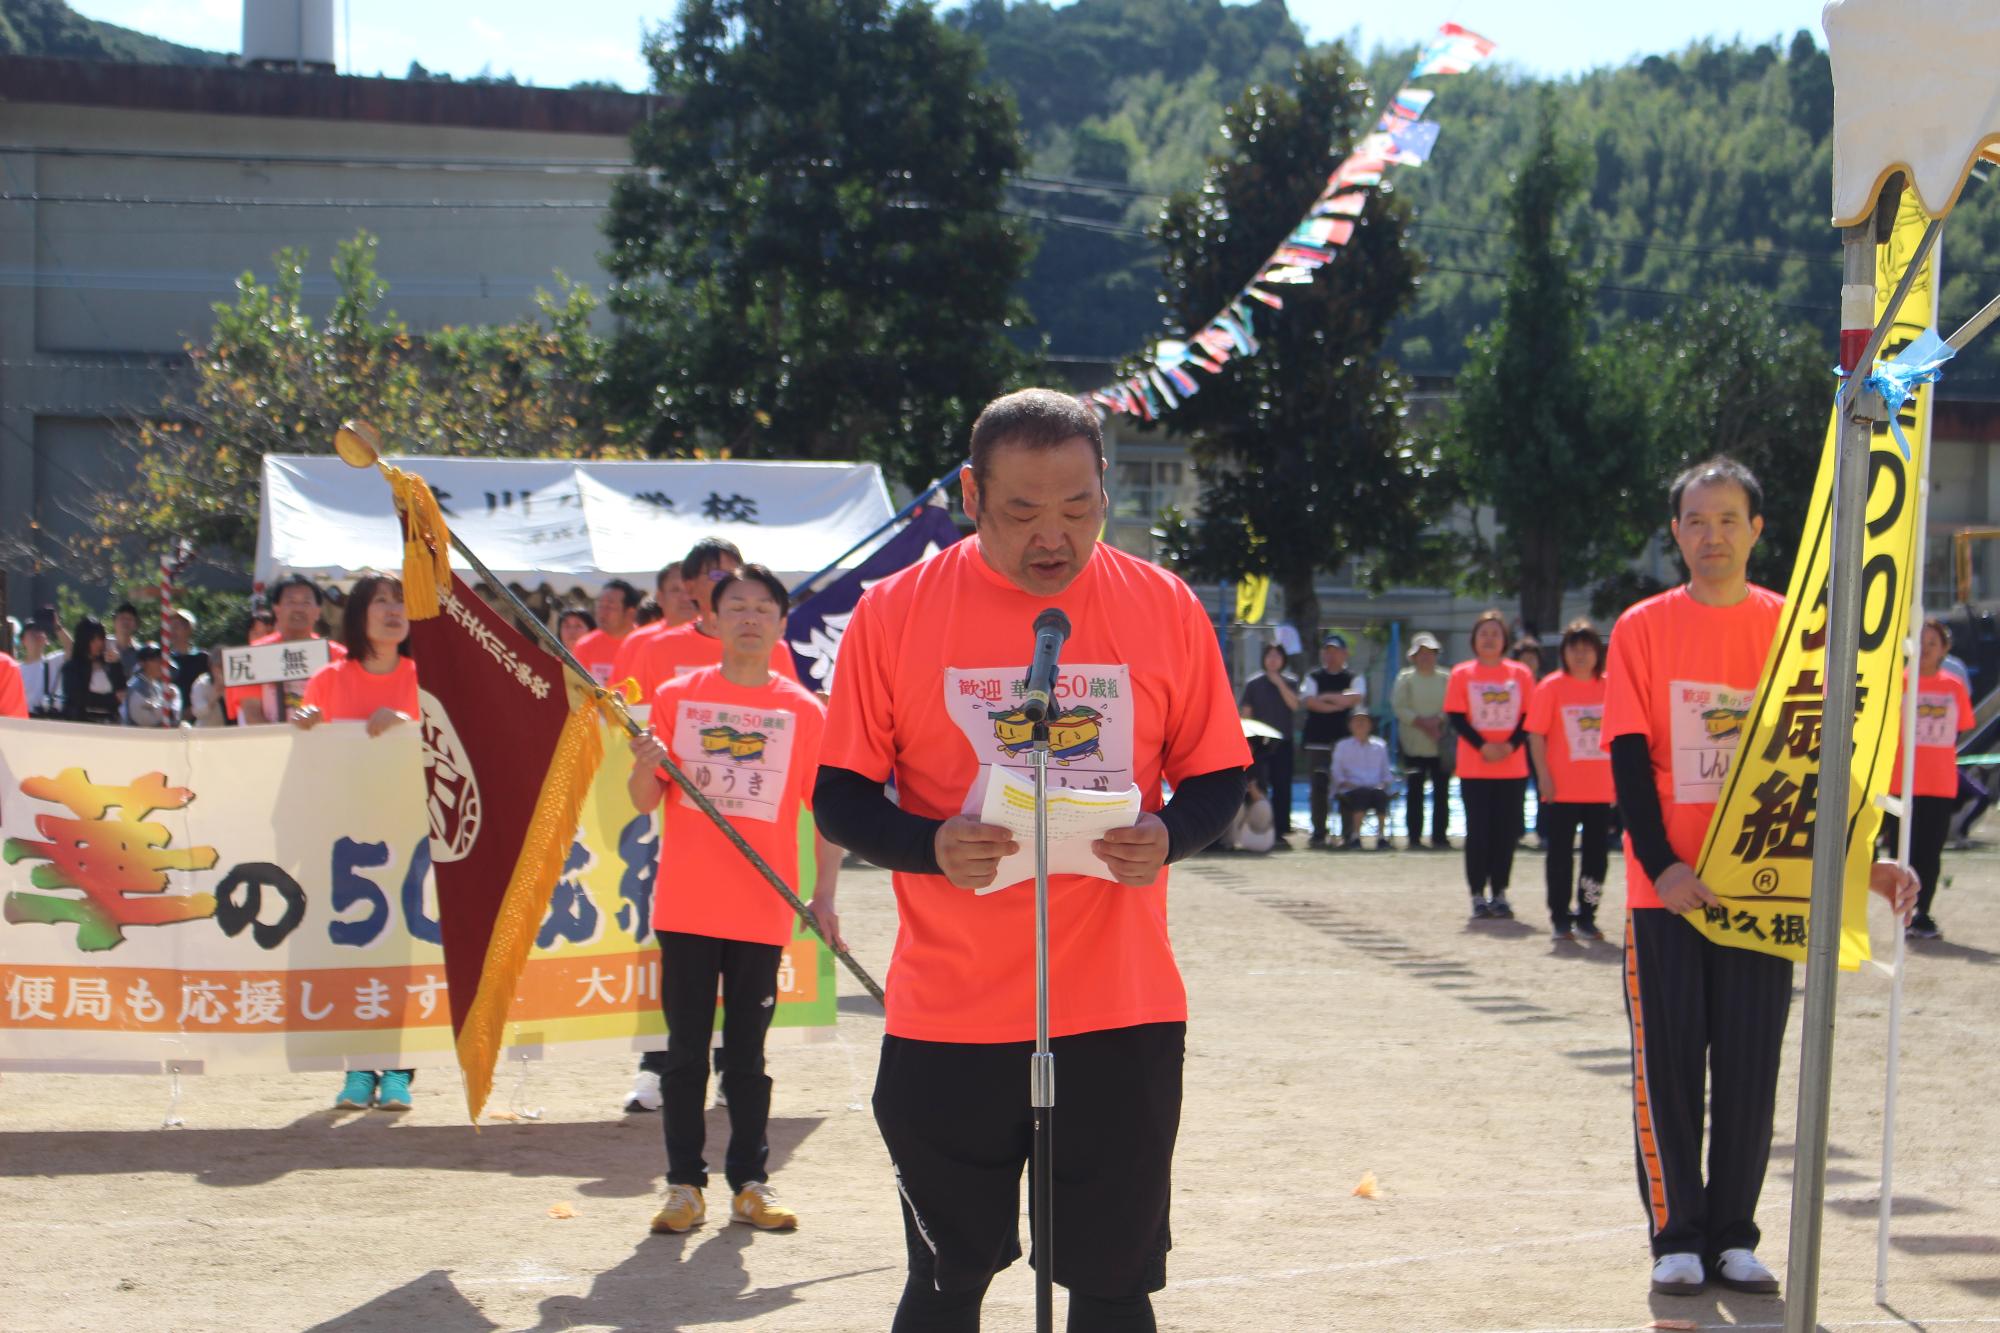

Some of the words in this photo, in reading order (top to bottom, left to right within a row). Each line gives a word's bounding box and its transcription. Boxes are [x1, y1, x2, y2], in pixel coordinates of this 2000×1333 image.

[228, 649, 308, 680] 尻無
[959, 679, 1002, 701] 歓迎
[1011, 675, 1119, 699] 華50歳組
[696, 766, 763, 796] ゆうき
